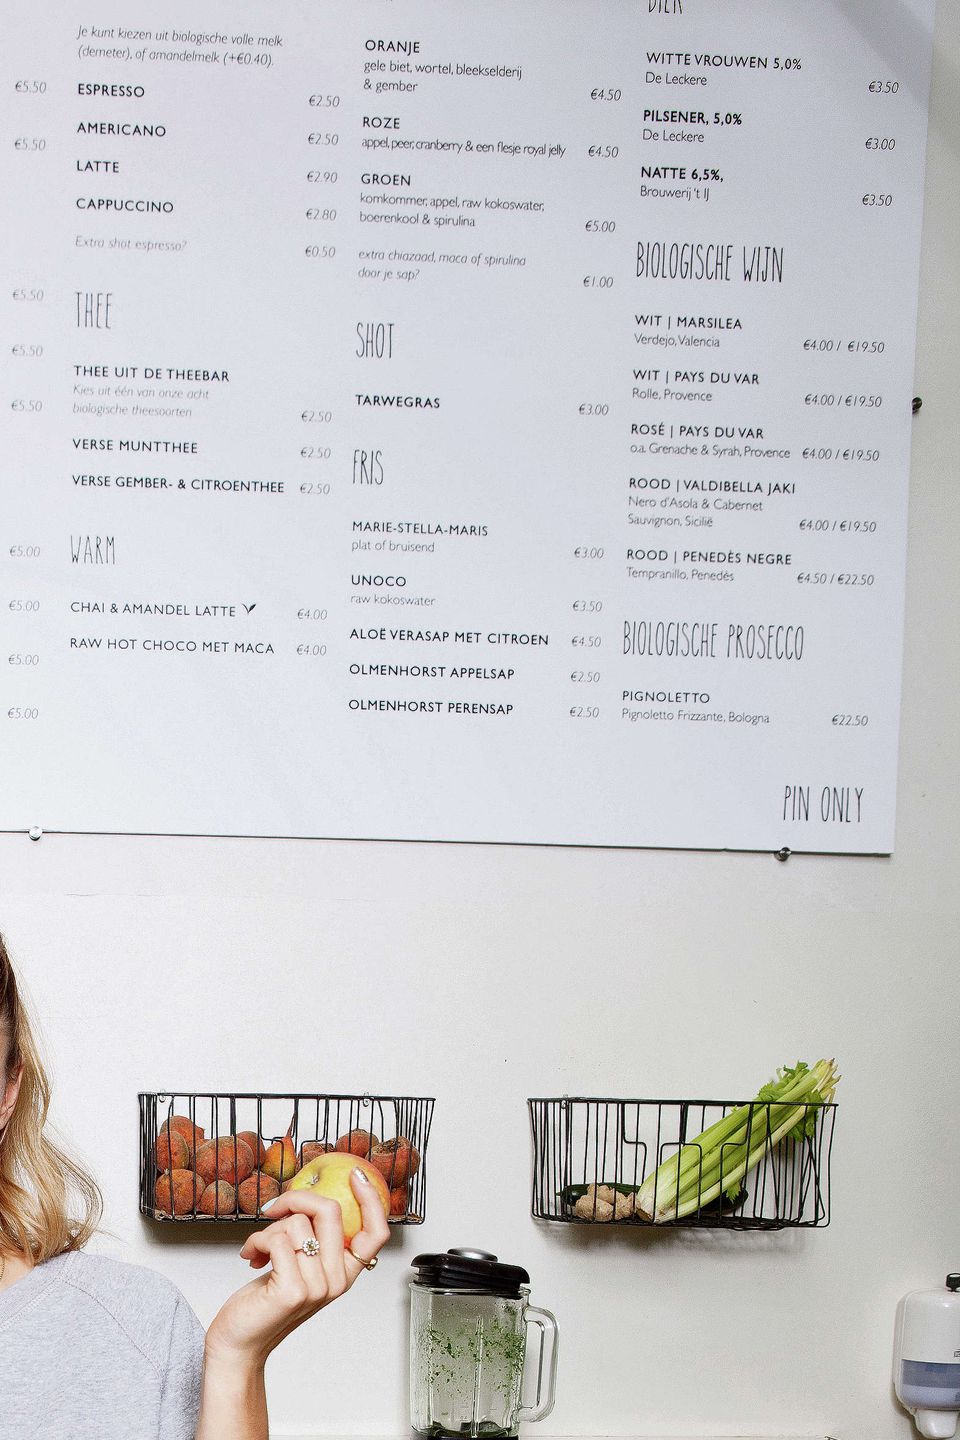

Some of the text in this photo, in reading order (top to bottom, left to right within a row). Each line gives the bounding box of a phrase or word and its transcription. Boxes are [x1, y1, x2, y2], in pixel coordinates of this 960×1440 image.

[364, 39, 420, 57] ORANJE
[646, 51, 802, 71] WITTE VROUWEN 5,0%
[363, 58, 522, 81] gele biet, wortel, bleekselderij
[14, 79, 47, 95] €5.50
[645, 71, 708, 87] De Leckere
[868, 80, 900, 94] €3.50
[78, 83, 145, 98] ESPRESSO
[590, 87, 622, 102] €4.50
[308, 94, 341, 108] €2.50
[362, 116, 400, 130] ROZE
[643, 109, 743, 127] PILSENER, 5,0%
[76, 122, 166, 138] AMERICANO
[587, 144, 619, 159] €4.50
[864, 137, 896, 151] €3.00
[76, 159, 119, 174] LATTE
[641, 165, 724, 183] NATTE 6,5%,
[360, 173, 411, 187] GROEN
[75, 197, 174, 214] CAPPUCCINO
[861, 193, 893, 207] €3.50
[584, 219, 616, 233] €5.00
[636, 241, 784, 283] BIOLOGISCHE WIJN
[76, 291, 113, 330] THEE
[634, 314, 743, 330] WIT MARSILEA
[355, 321, 395, 359] SHOT
[73, 365, 230, 382] THEE UIT DE THEEBAR
[632, 369, 760, 385] WIT PAYS DU VAR
[355, 394, 440, 409] TARWEGRAS
[630, 421, 764, 440] ROSÉ PAYS DU VAR
[72, 438, 198, 454] VERSE MUNTTHEE
[352, 448, 384, 486] FRIS
[71, 474, 284, 493] VERSE GEMBER- & CITROENTHEE
[629, 477, 795, 497] ROOD VALDIBELLA JAKI
[352, 521, 488, 537] MARIE-STELLA-MARIS
[70, 535, 116, 565] WARM
[626, 548, 669, 561] ROOD
[746, 553, 792, 566] NEGRE
[351, 574, 407, 588] UNOCO
[70, 601, 236, 618] CHAI & AMANDEL LATTE
[349, 627, 549, 646] ALOË VERASAP MET CITROEN
[623, 620, 804, 661] BIOLOGISCHE PROSECCO
[70, 637, 275, 654] RAW HOT CHOCO MET MACA
[349, 663, 515, 680] OLMENHORST APPELSAP
[622, 690, 710, 704] PIGNOLETTO
[348, 699, 514, 715] OLMENHORST PERENSAP
[783, 785, 864, 823] PIN ONLY
